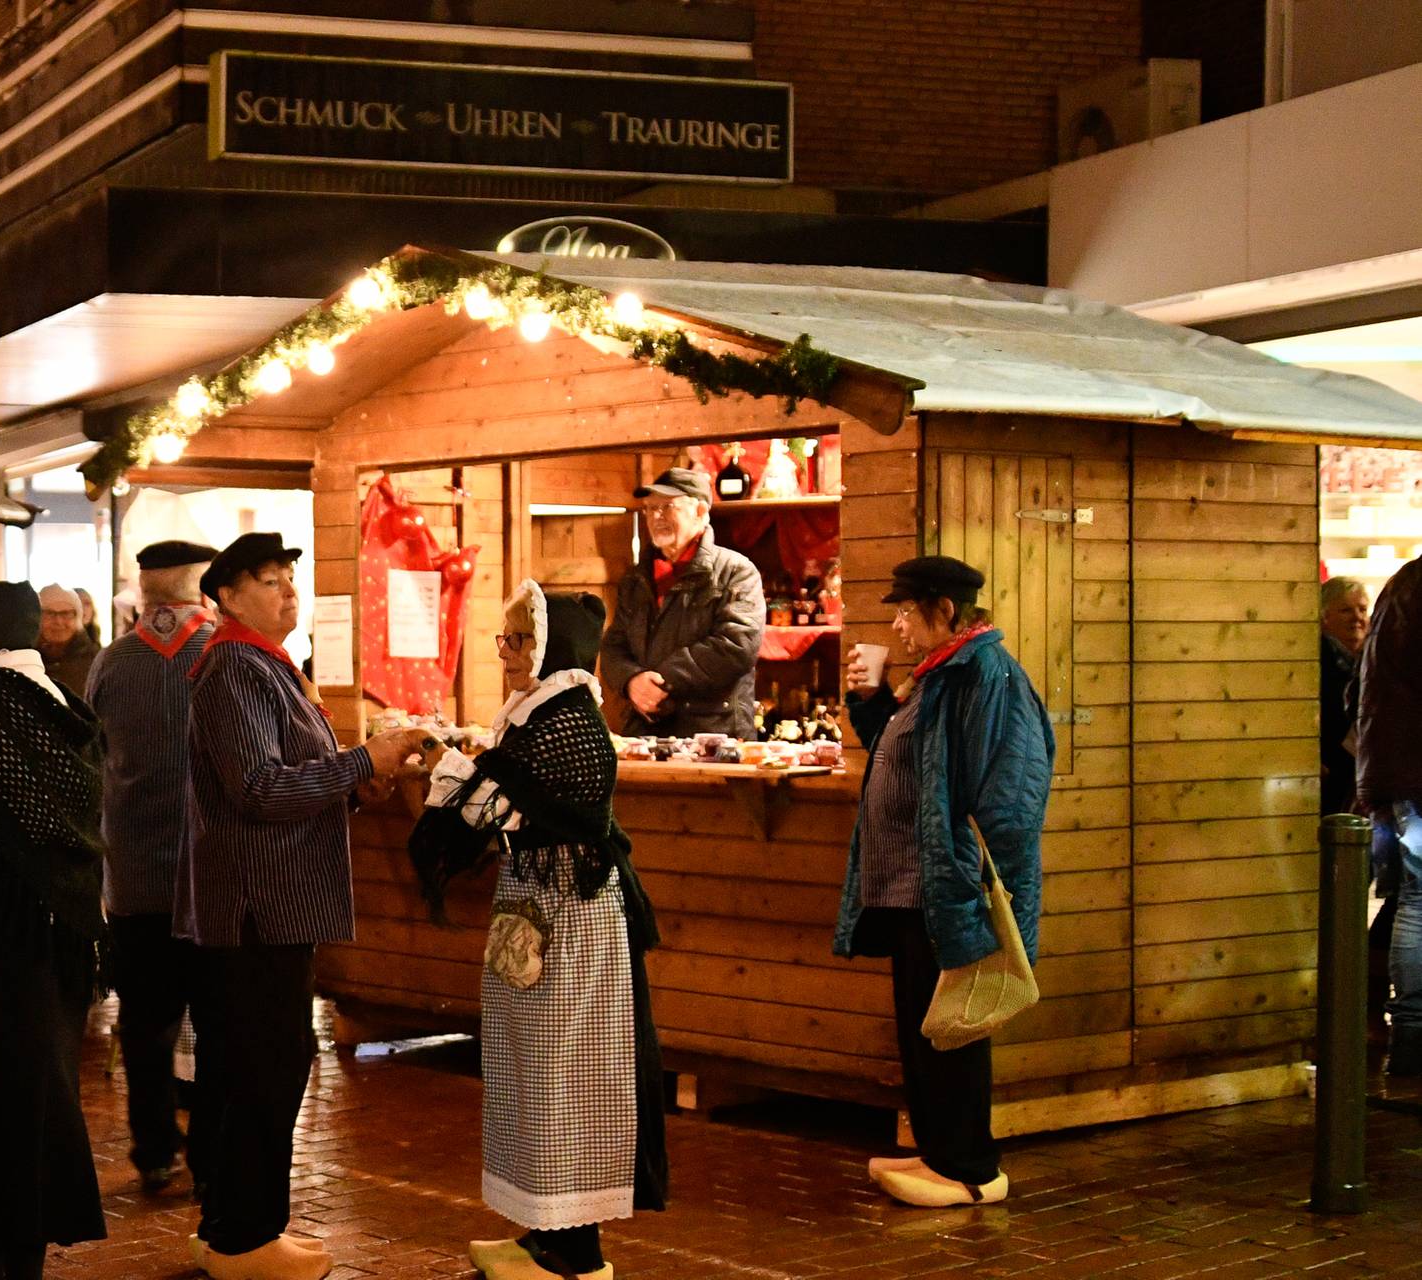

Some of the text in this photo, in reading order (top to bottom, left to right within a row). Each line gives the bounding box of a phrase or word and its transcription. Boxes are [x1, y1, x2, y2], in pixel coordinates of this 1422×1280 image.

[234, 90, 781, 150] SCHMUCK UHREN TRAURINGE
